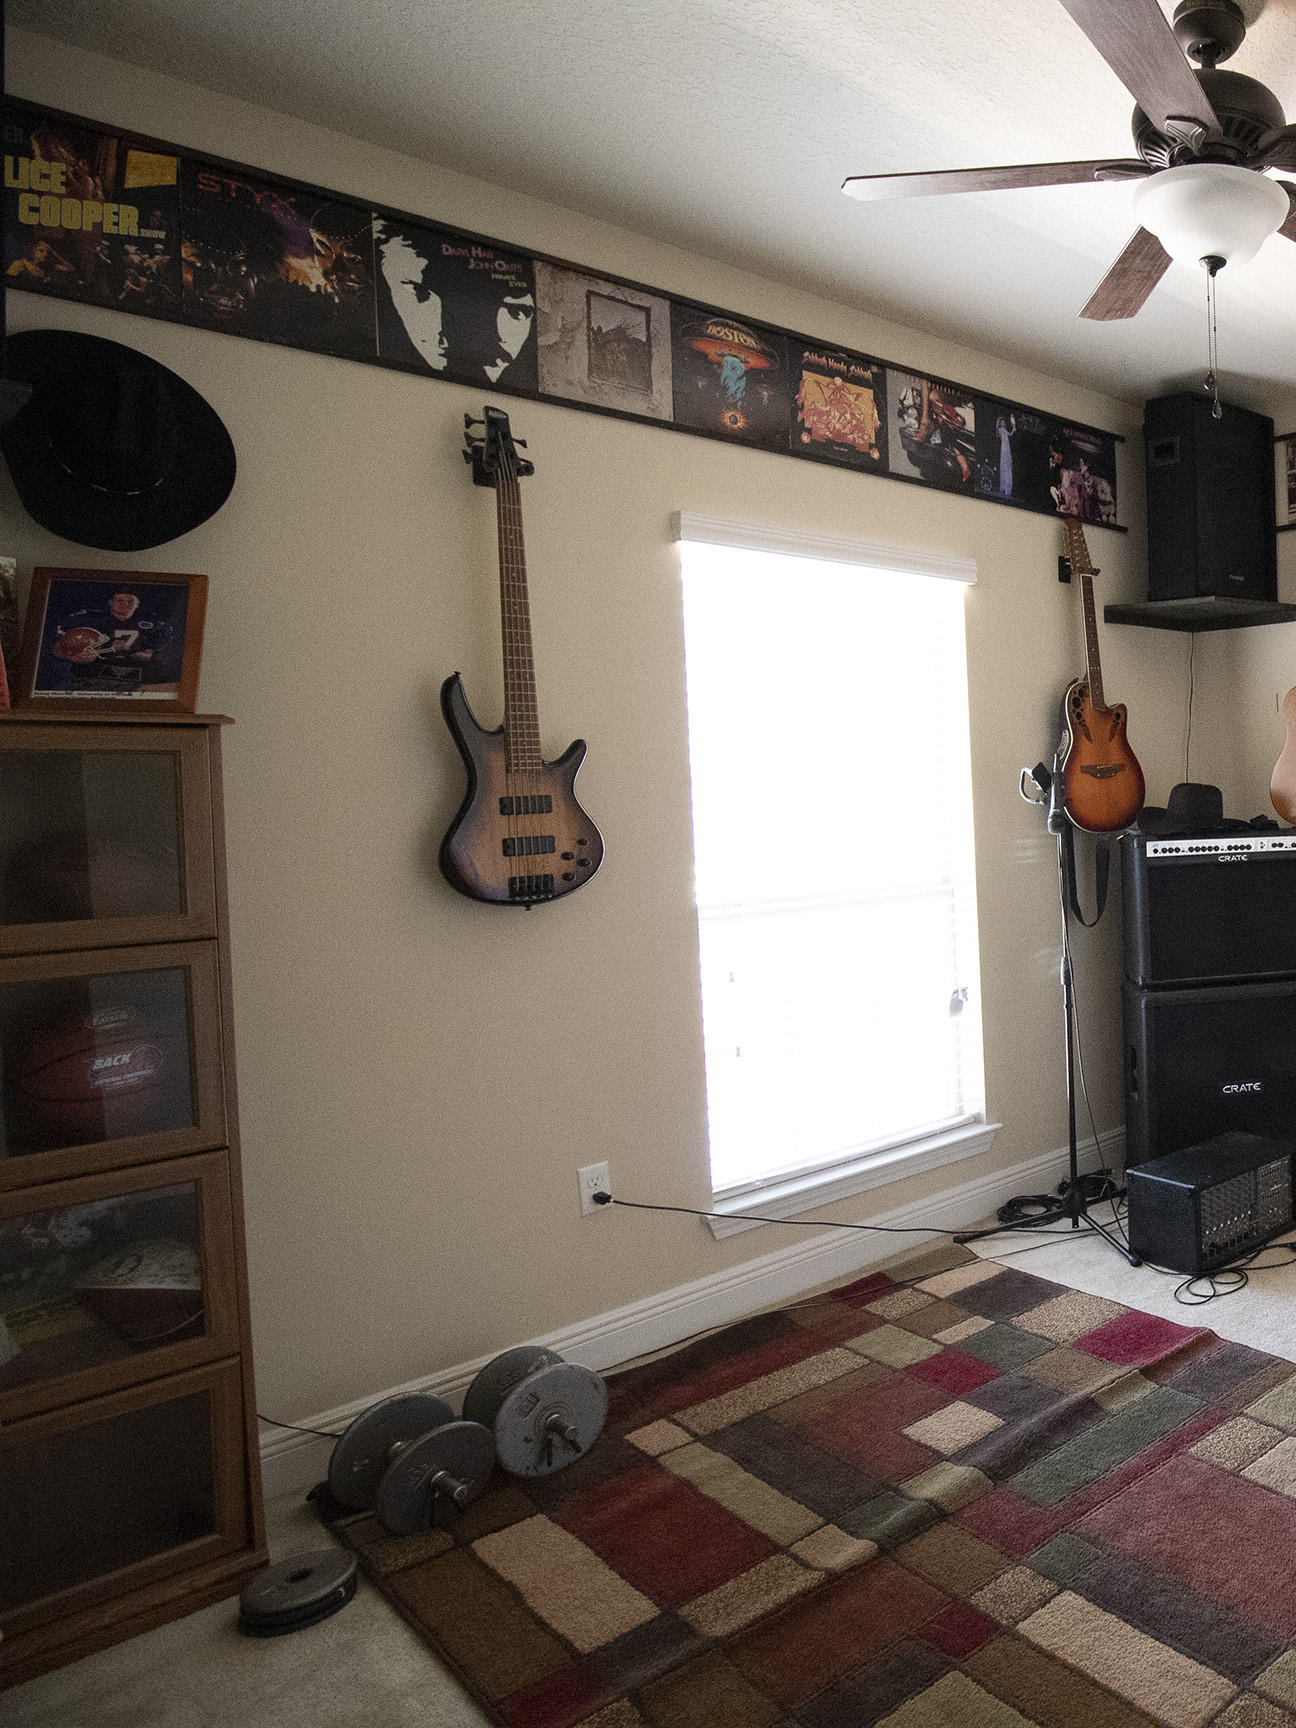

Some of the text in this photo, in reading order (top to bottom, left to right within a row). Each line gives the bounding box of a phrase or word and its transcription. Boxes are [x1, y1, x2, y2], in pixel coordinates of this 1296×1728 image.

[4, 155, 66, 194] LICE
[19, 193, 139, 236] COOPER
[706, 325, 758, 349] BOSTON
[1218, 854, 1248, 863] CRATE
[93, 1053, 132, 1070] BACK
[1222, 1082, 1261, 1094] CRATE
